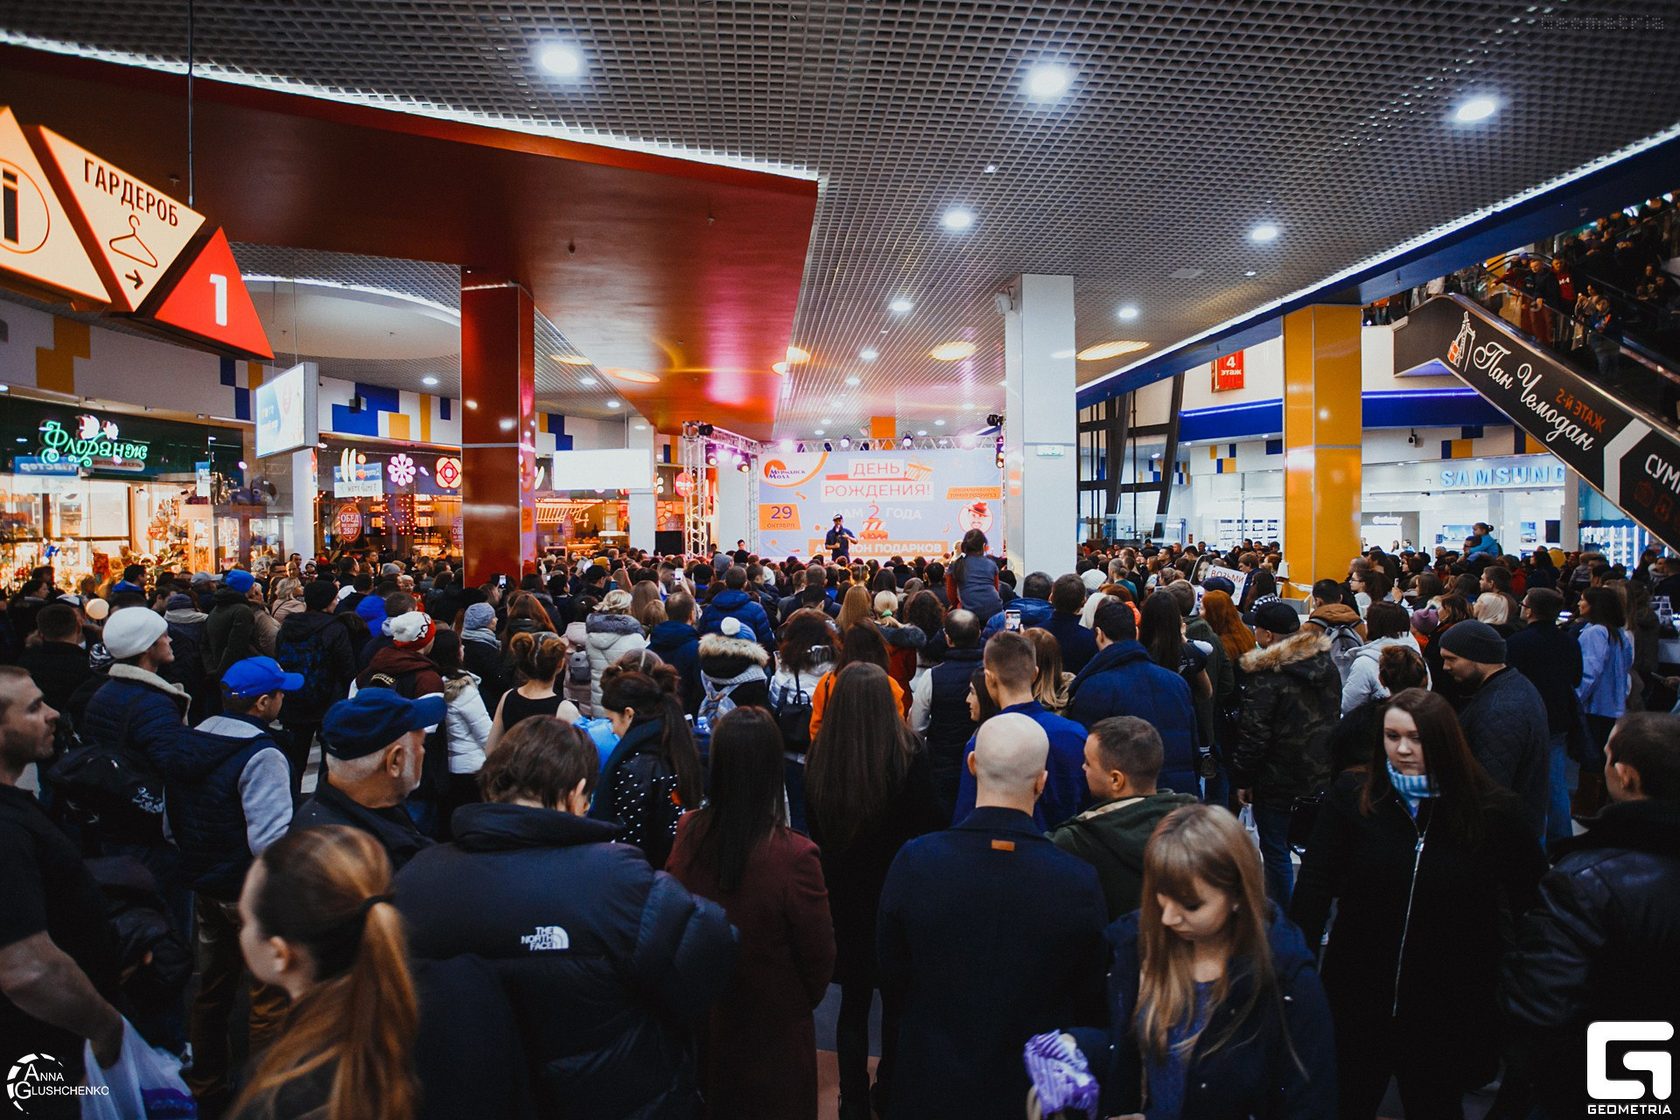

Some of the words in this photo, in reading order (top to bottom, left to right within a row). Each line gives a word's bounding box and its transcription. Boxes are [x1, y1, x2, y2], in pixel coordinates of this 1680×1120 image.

[84, 157, 178, 227] ГАРДЕРОБ
[209, 273, 228, 327] 1
[1226, 356, 1237, 368] 4
[1473, 341, 1514, 390] Пан
[1517, 363, 1595, 451] Чемодан
[1572, 400, 1607, 433] ЭТАЖ
[42, 420, 148, 467] Флоранж
[853, 463, 900, 476] ДЕНЬ
[1440, 464, 1566, 487] SAMSUNG
[1645, 453, 1680, 495] СУМ
[824, 484, 931, 497] РОЖДЕНИЯ!
[340, 514, 360, 523] ОБЕД
[771, 505, 792, 519] 29
[868, 504, 880, 519] 2
[885, 507, 922, 519] ГОДА
[875, 543, 943, 553] ПОДАРКОВ
[535, 926, 554, 935] THE
[521, 934, 552, 944] NORTH
[530, 943, 553, 951] FACE
